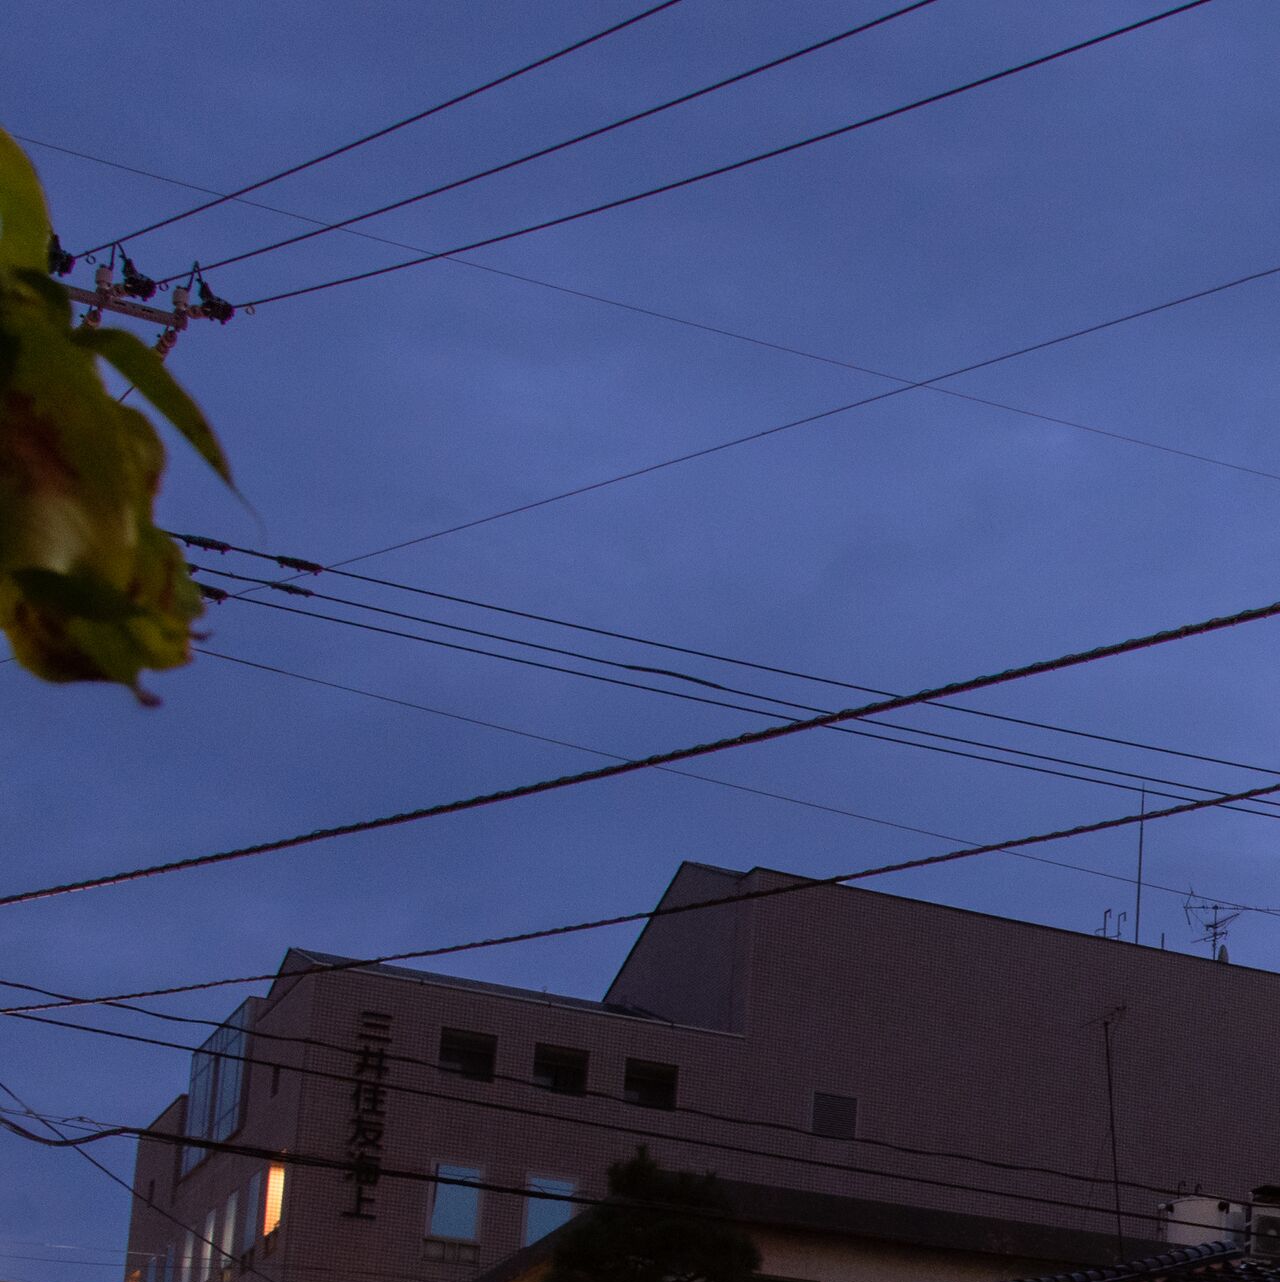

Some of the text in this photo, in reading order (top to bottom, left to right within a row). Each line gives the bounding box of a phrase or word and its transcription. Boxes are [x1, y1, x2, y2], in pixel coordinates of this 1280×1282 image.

[341, 1011, 393, 1219] 三井住友海上
